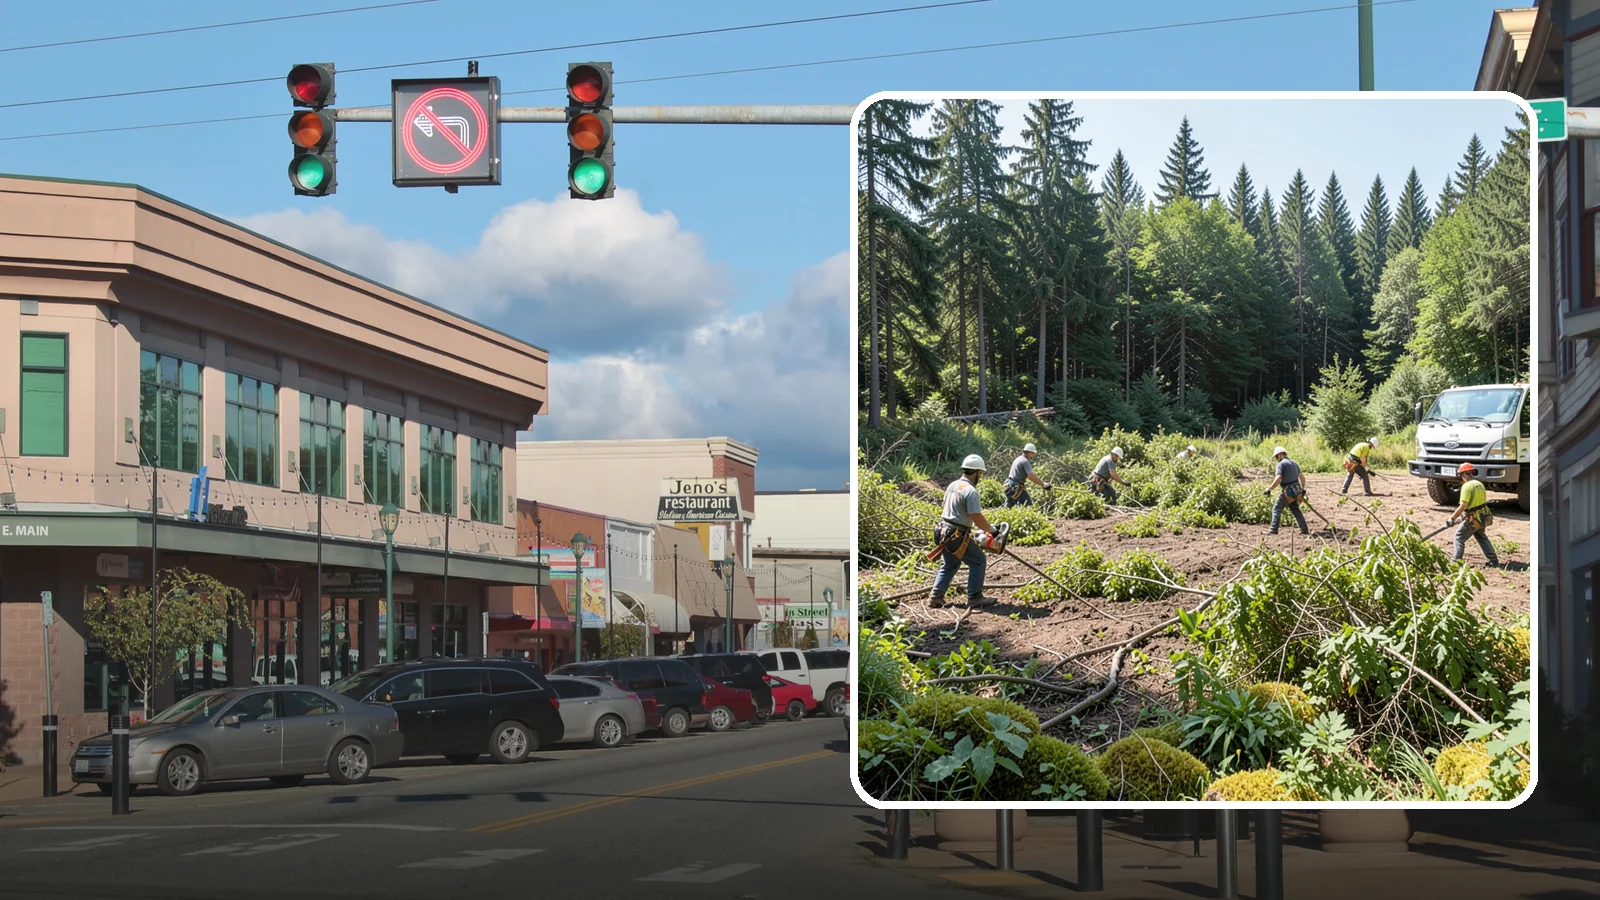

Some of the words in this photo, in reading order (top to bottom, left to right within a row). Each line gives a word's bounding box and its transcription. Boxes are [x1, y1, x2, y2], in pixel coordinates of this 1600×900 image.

[669, 480, 728, 495] Jeno's
[665, 496, 731, 509] restaurant
[658, 509, 682, 520] Italian
[686, 509, 714, 519] American
[715, 509, 738, 519] Cuisine
[2, 525, 13, 536] E.
[15, 525, 49, 536] MAIN
[797, 607, 829, 617] Street
